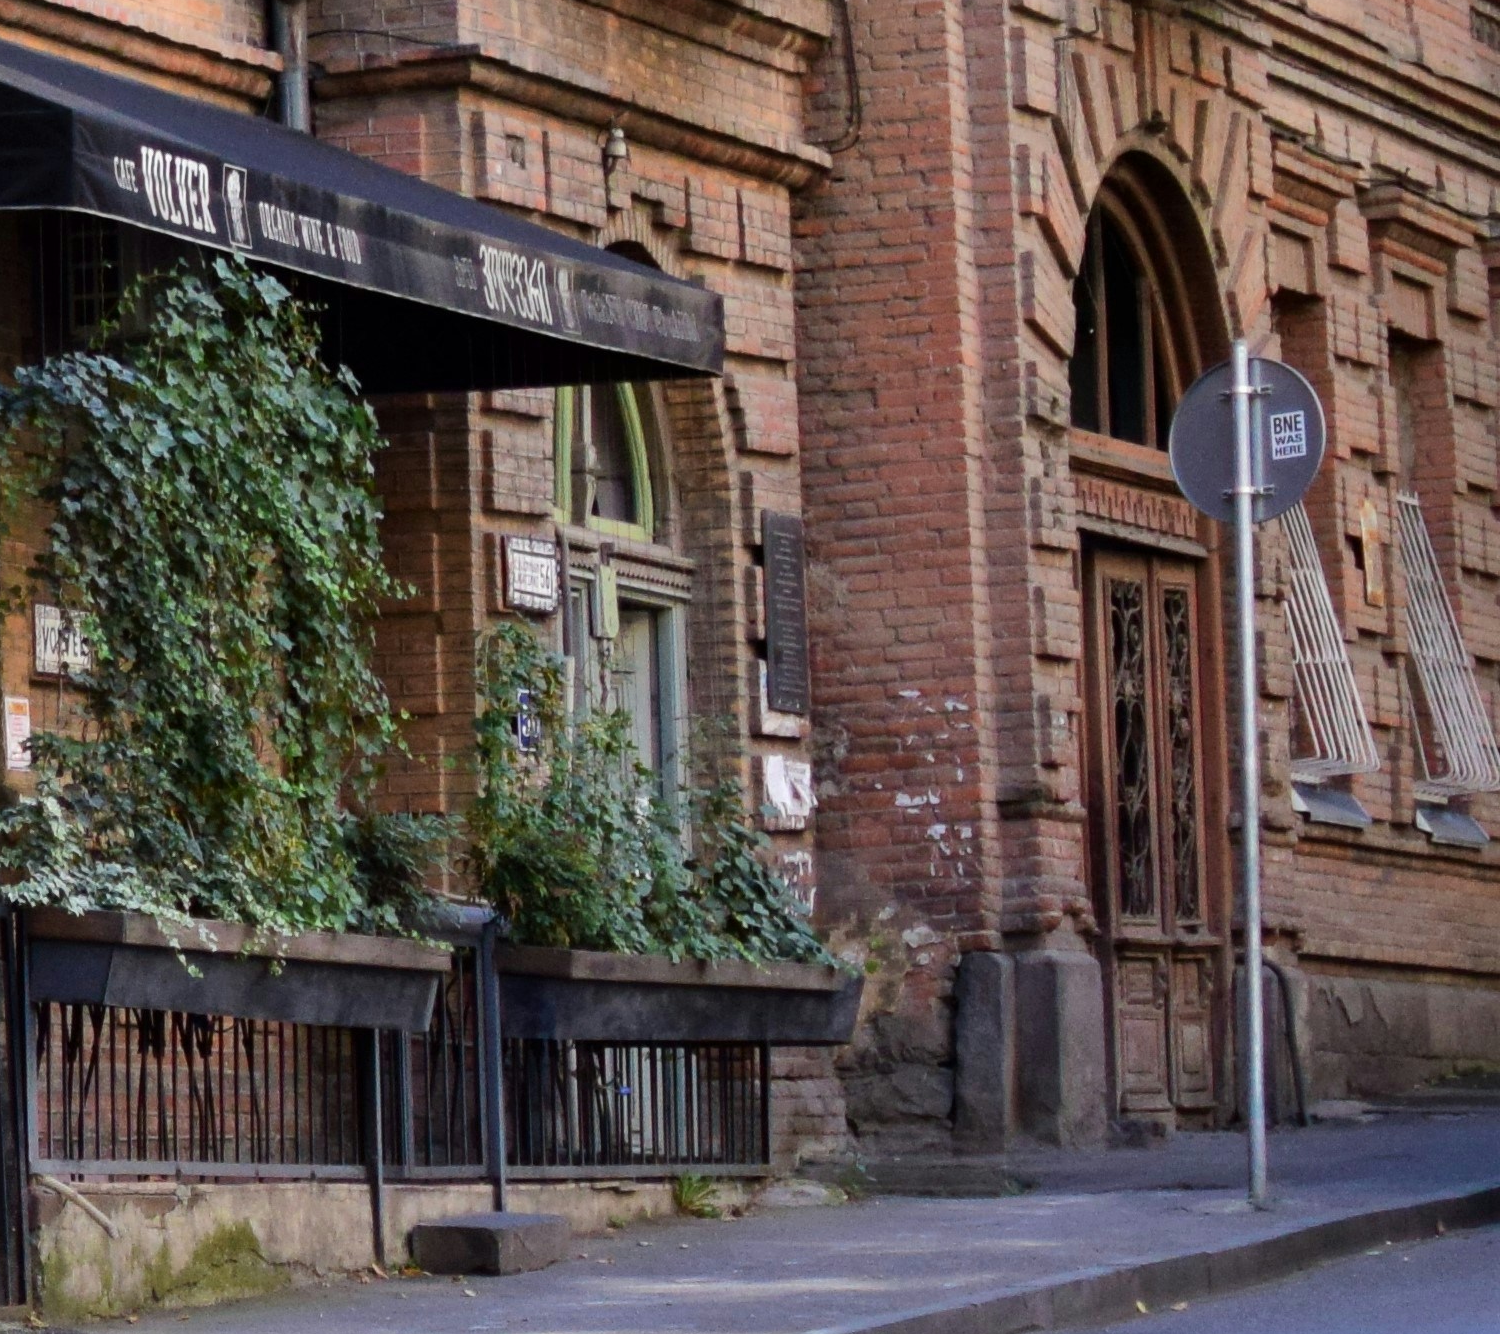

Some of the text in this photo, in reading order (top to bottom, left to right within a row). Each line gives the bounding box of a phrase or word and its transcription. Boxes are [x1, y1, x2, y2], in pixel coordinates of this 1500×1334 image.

[113, 145, 363, 265] CAFE VOLVER ORGANIC WINE & FOOD
[1273, 414, 1302, 434] BNE
[1274, 433, 1303, 445] WAS
[1275, 444, 1304, 457] HERE
